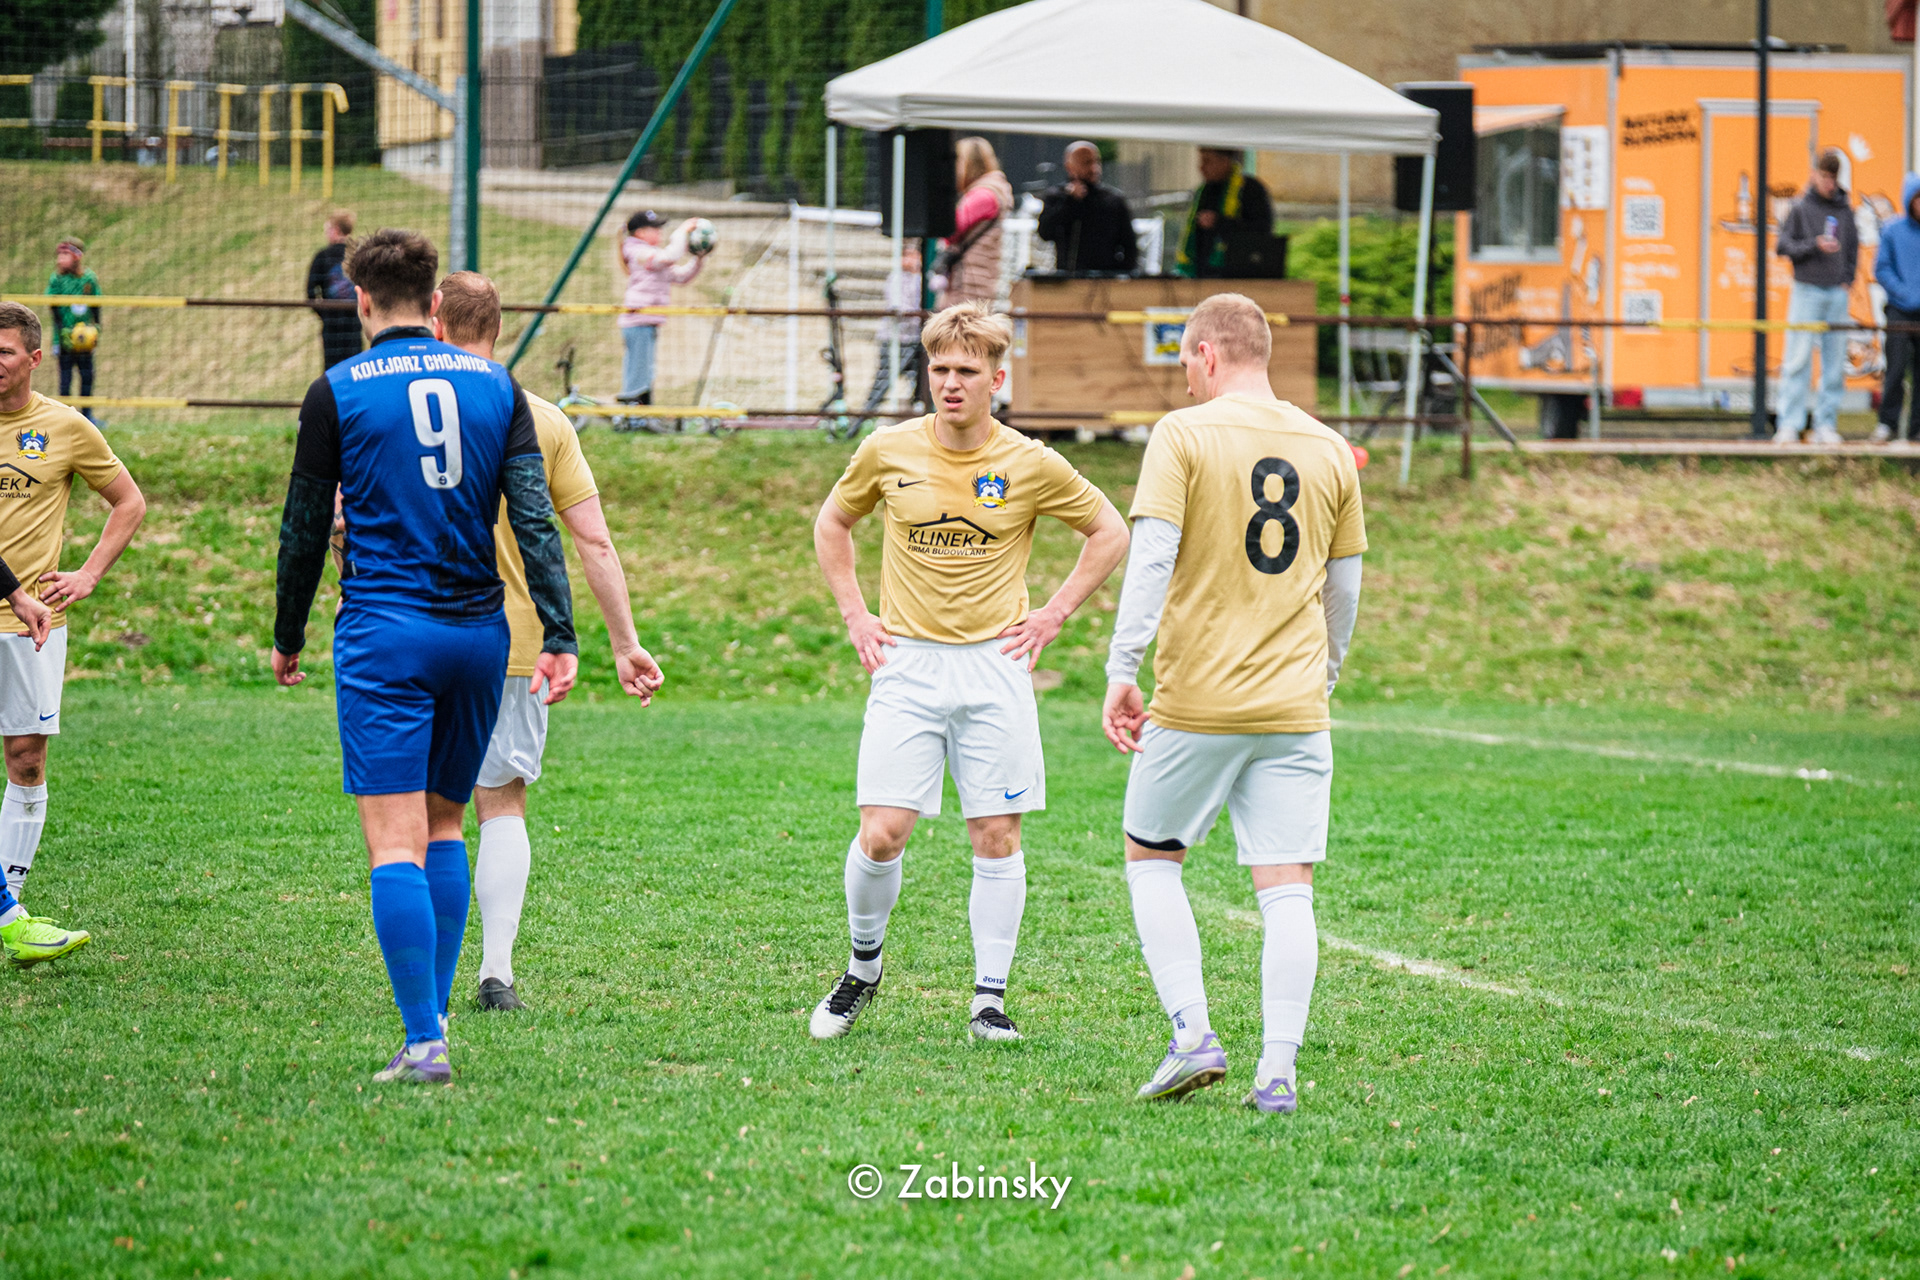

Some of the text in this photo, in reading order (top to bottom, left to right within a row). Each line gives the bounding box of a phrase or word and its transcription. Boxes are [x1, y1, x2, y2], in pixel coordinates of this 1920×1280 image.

[351, 353, 492, 382] KOLEJARZ CHOJNICE
[408, 378, 463, 490] 9
[907, 545, 987, 556] FIRMA BUDOWLANA
[1245, 457, 1300, 575] 8
